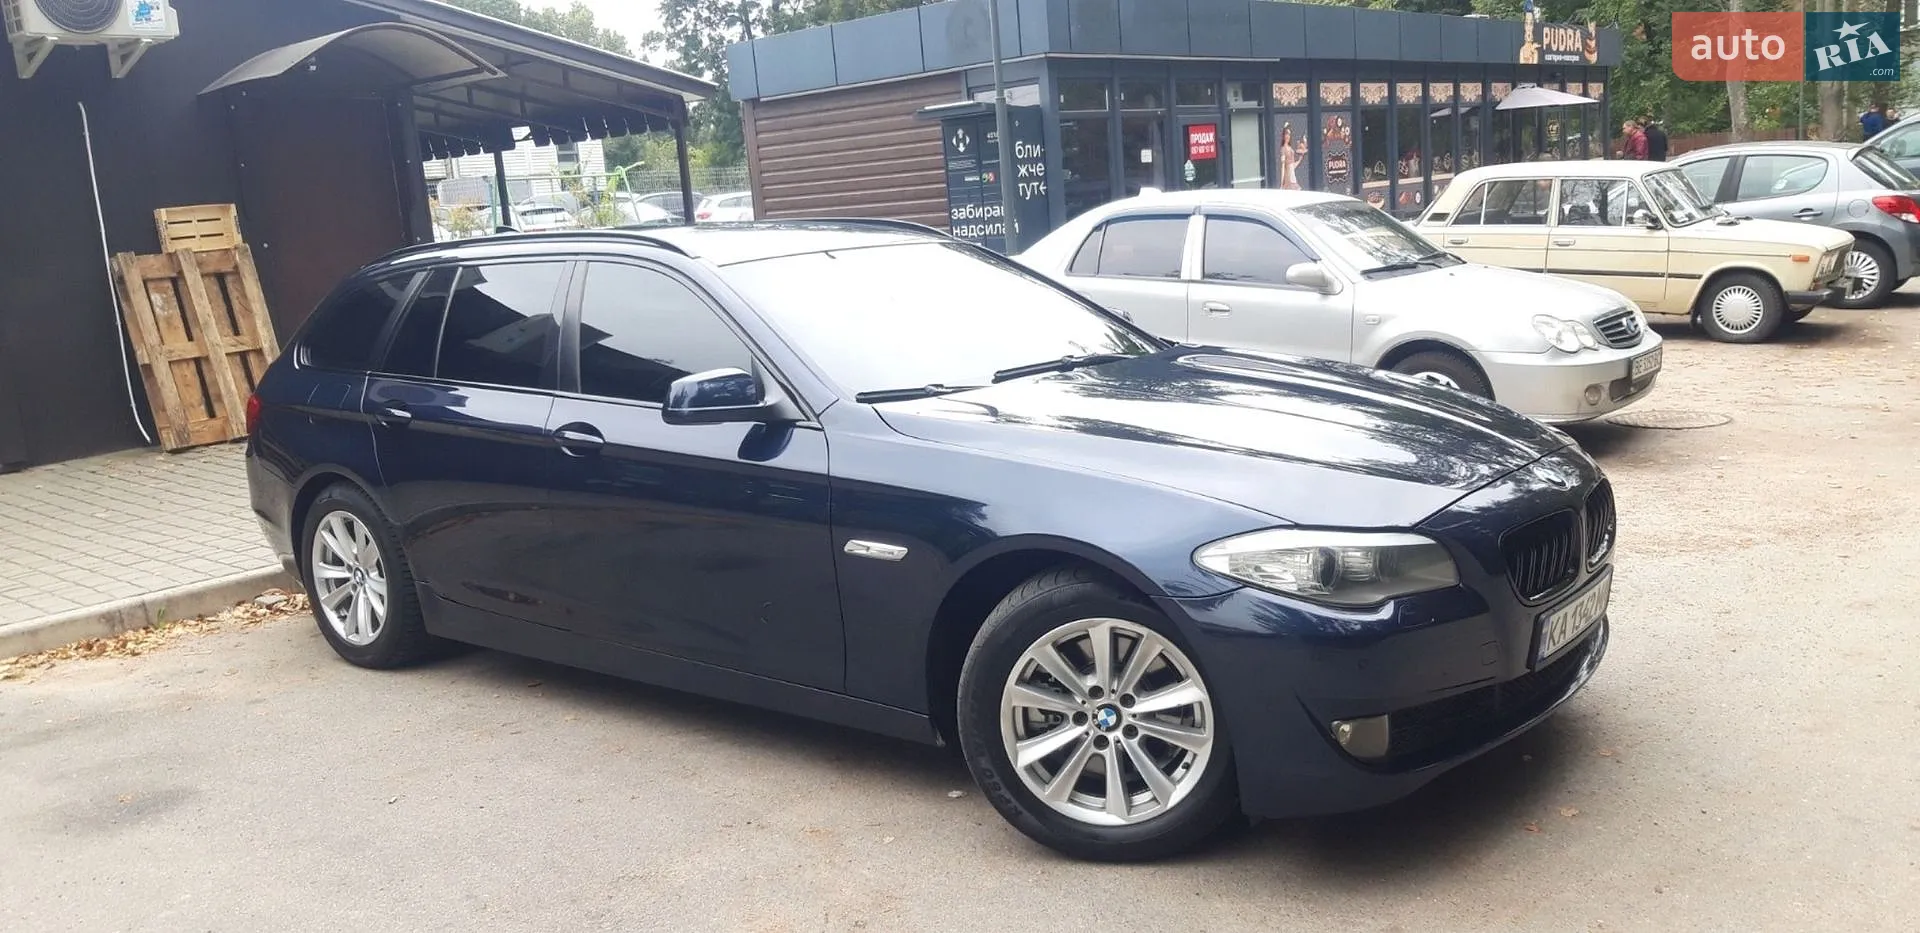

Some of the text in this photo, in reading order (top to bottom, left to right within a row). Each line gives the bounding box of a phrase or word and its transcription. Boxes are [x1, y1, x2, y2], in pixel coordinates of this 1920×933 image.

[1543, 26, 1583, 52] PUDRA
[1017, 163, 1045, 177] жче
[1018, 181, 1039, 200] тут
